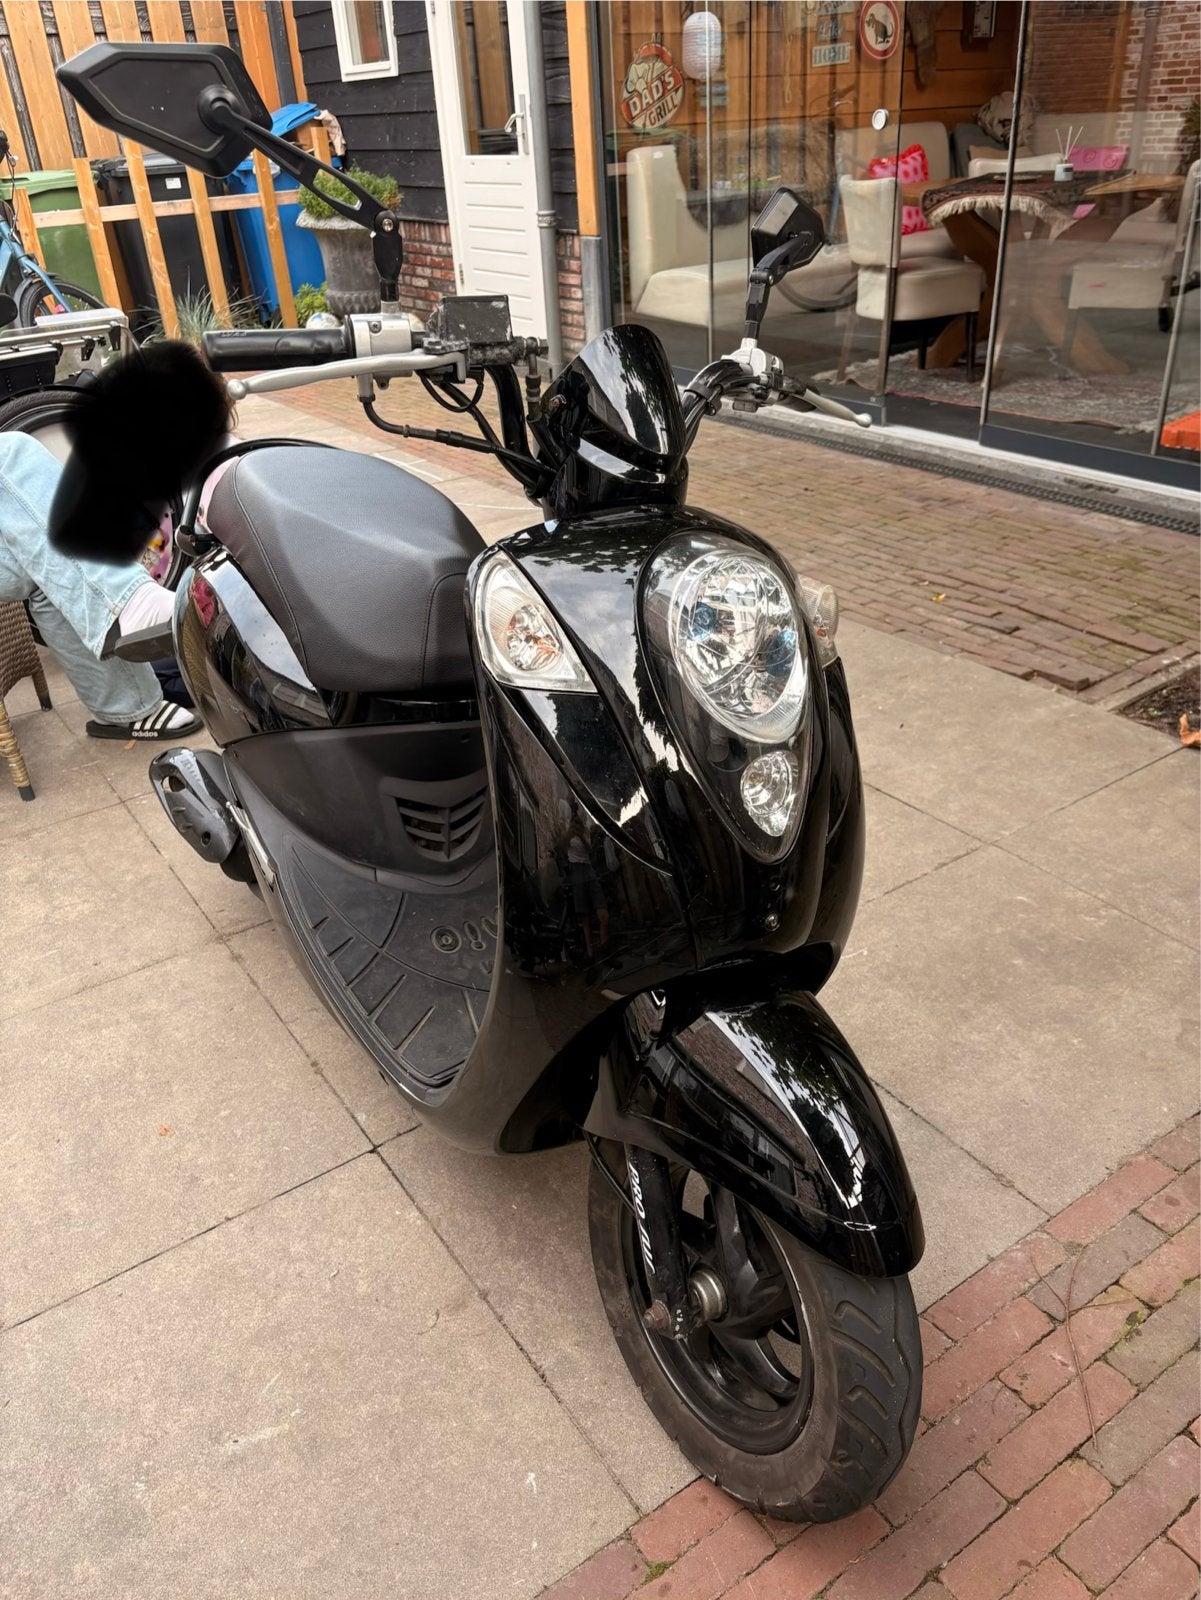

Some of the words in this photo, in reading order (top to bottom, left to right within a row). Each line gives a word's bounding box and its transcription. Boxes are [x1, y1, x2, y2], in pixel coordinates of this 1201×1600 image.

[628, 70, 675, 118] DAD'S
[648, 94, 678, 127] GRILL
[131, 730, 159, 738] adidas
[628, 1161, 646, 1220] PRO
